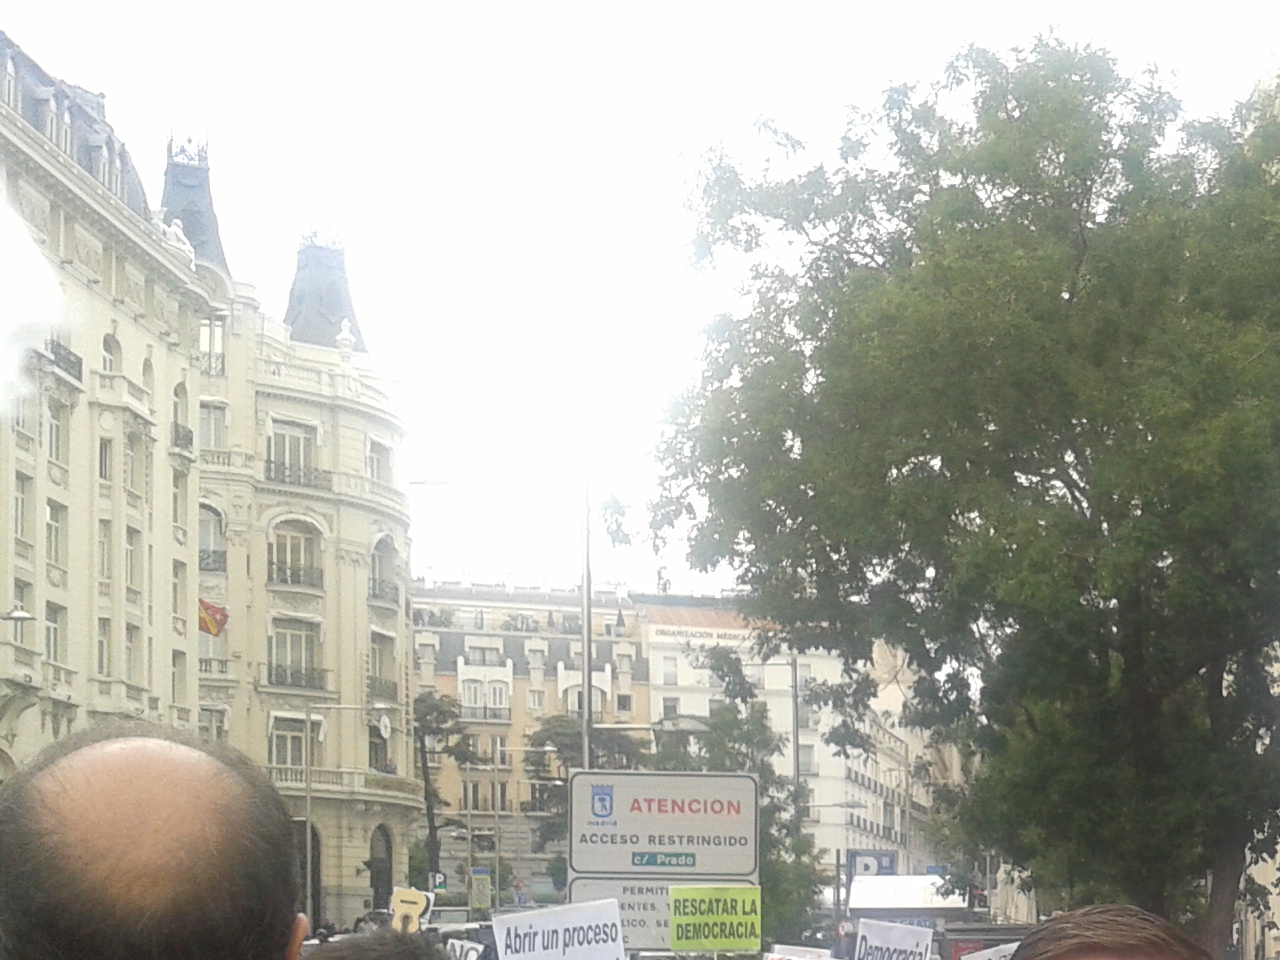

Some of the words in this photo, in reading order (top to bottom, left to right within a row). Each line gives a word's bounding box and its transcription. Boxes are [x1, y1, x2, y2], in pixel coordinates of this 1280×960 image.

[630, 798, 741, 815] ATENCION
[579, 833, 640, 845] ACCESO
[648, 835, 748, 847] RESTRINGIDO
[657, 854, 694, 865] Prado
[435, 873, 444, 886] P
[674, 898, 738, 916] RESCATAR
[742, 898, 758, 916] LA
[505, 924, 538, 956] Abrir
[542, 928, 559, 951] un
[563, 922, 618, 956] proceso
